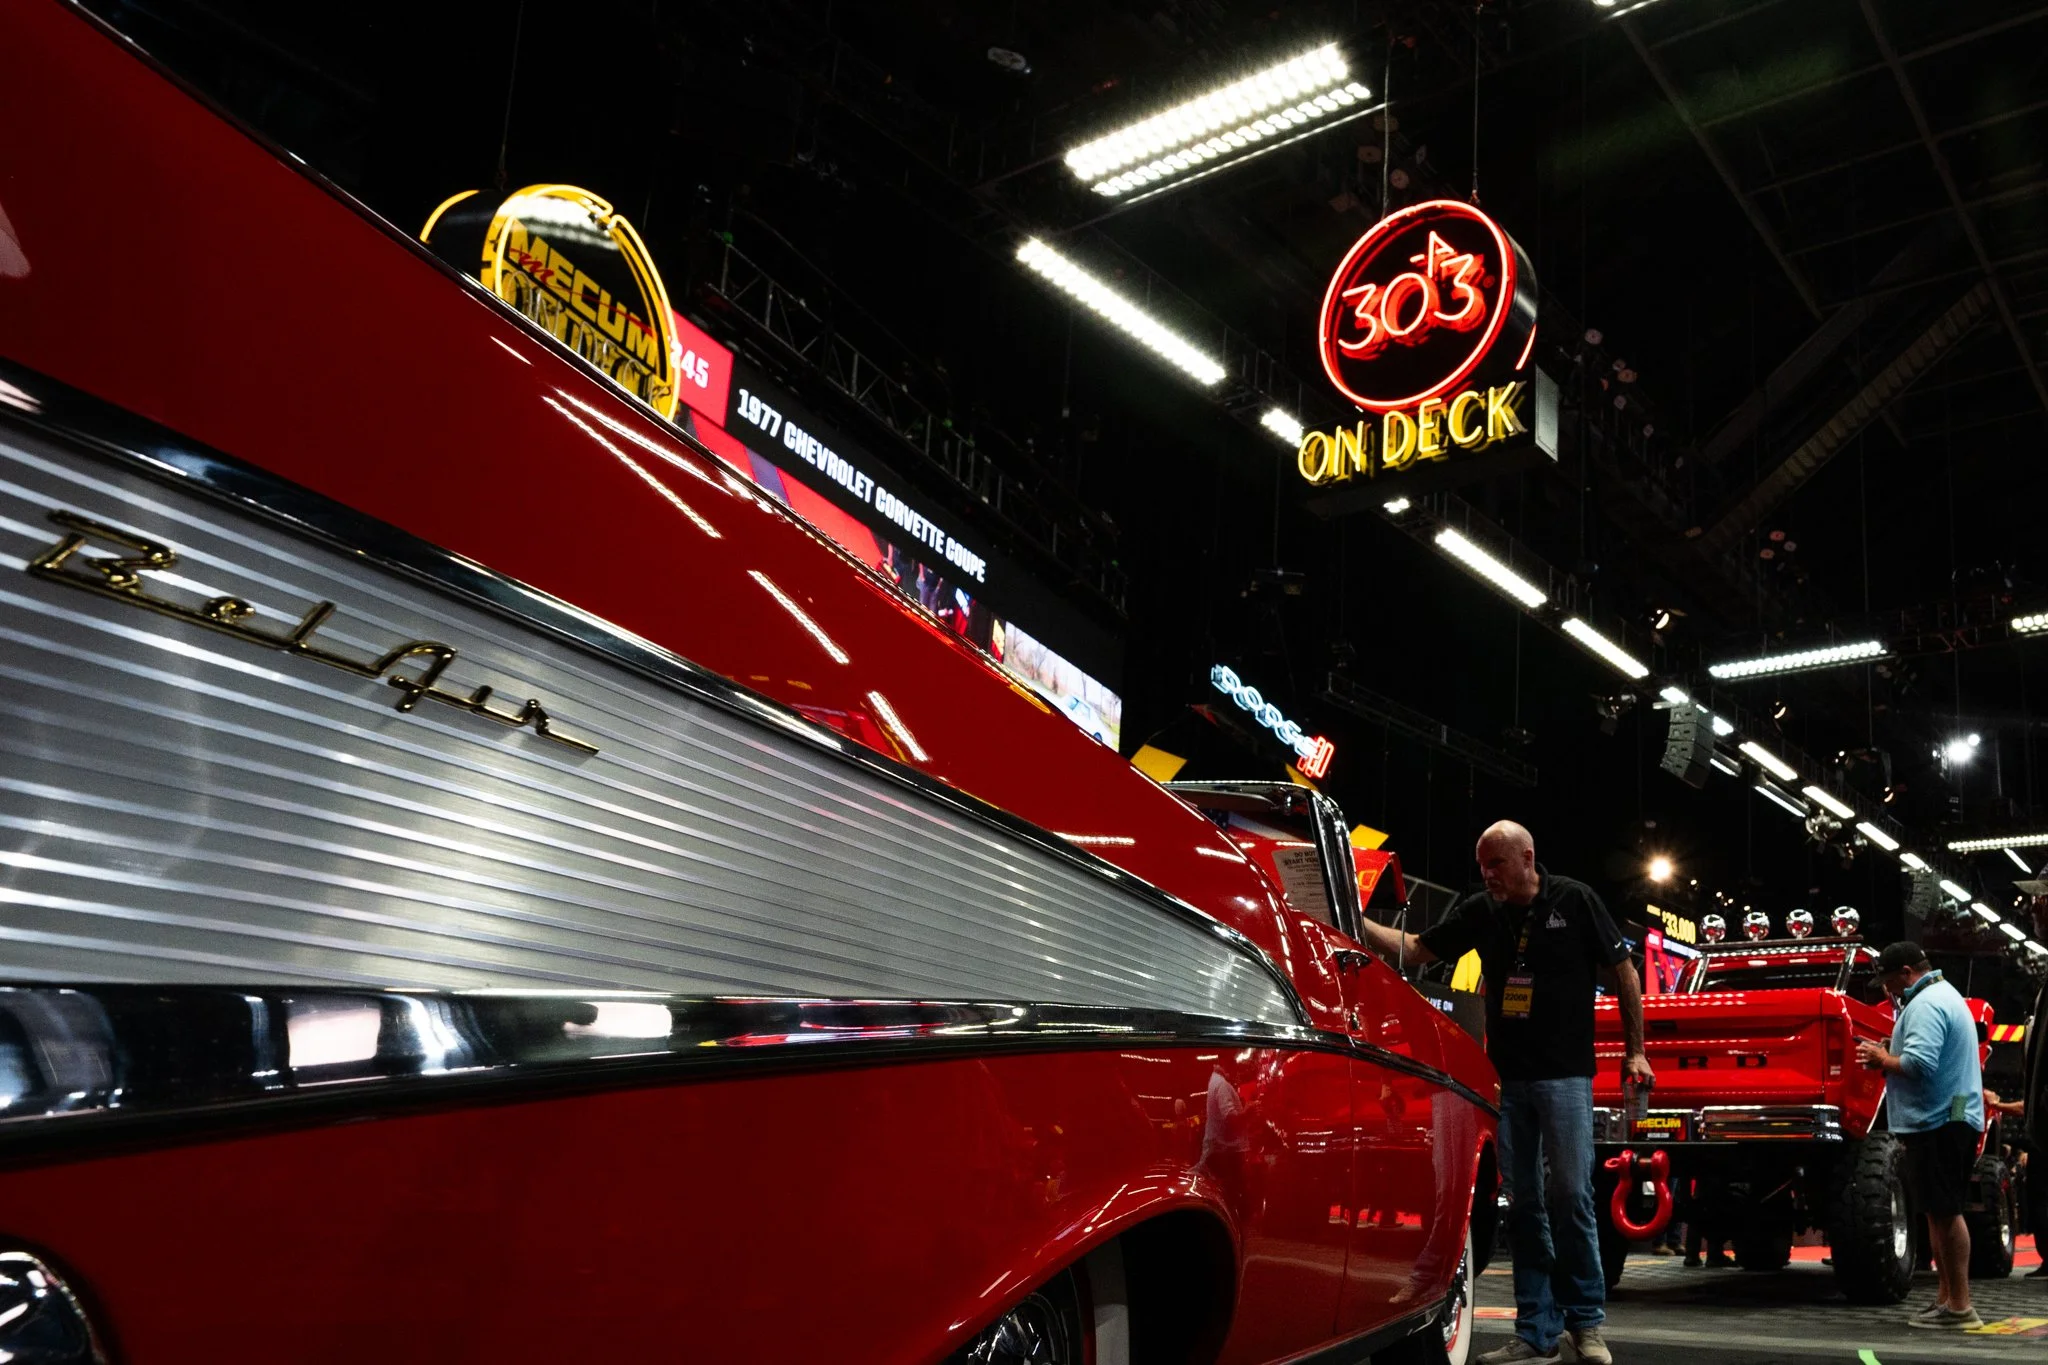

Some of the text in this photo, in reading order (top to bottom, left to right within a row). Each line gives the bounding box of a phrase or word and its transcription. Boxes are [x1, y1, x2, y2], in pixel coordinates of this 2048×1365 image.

[509, 219, 659, 374] MECUM
[737, 388, 987, 583] 1977 CHEVROLET CORVETTE COUPE
[1298, 380, 1521, 483] ON DECK
